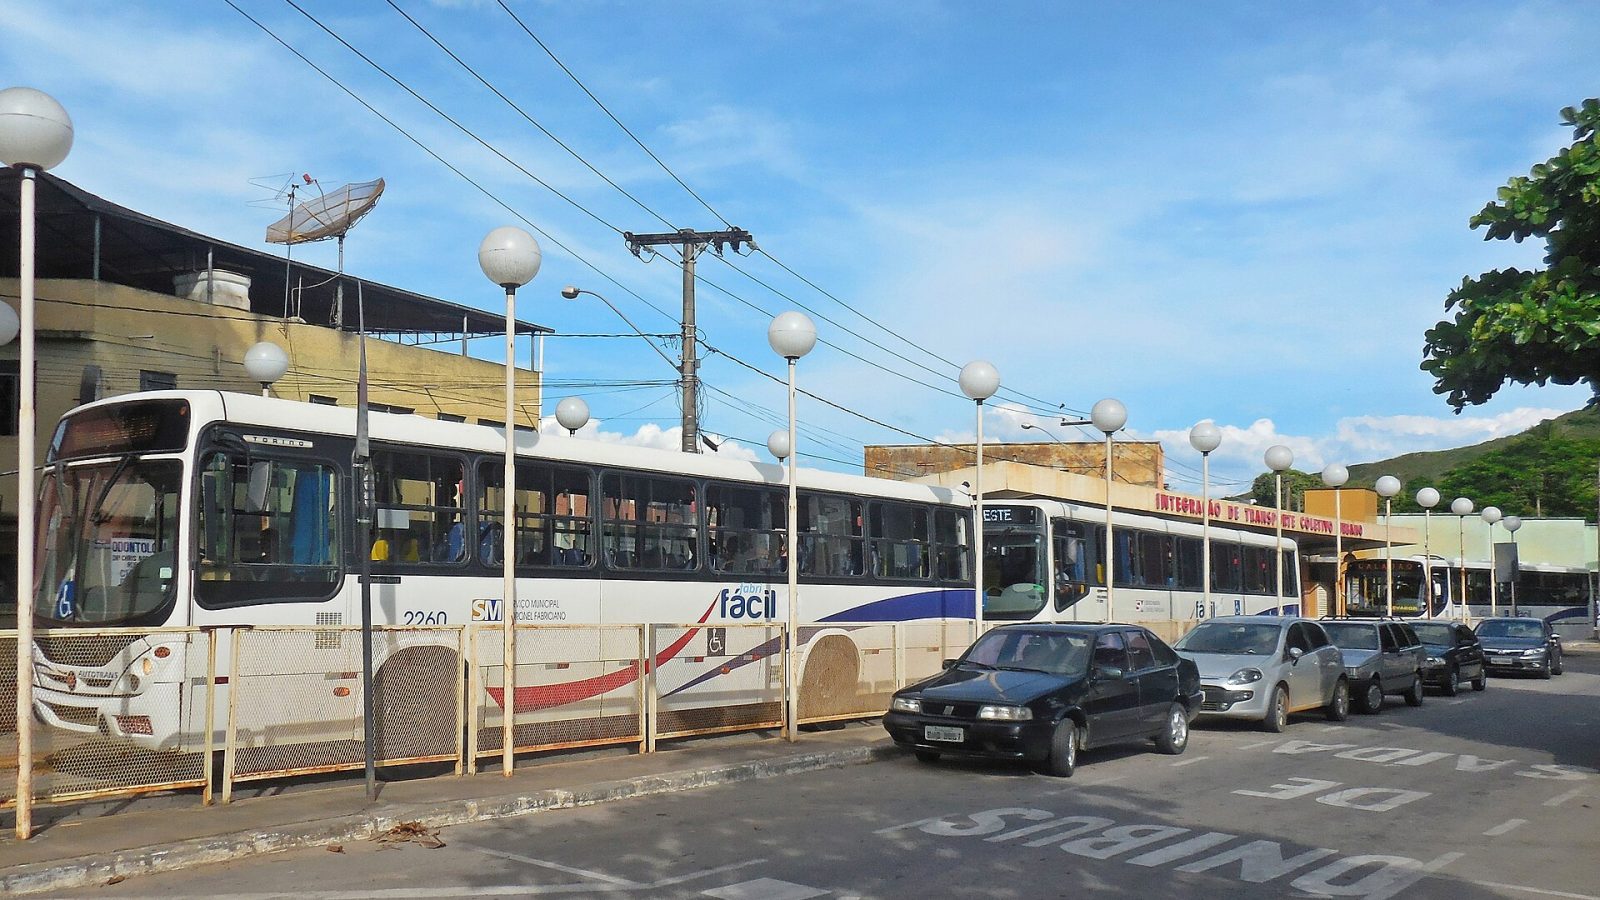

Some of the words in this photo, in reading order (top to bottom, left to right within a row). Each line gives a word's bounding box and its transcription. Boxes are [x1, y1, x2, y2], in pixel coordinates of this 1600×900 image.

[252, 436, 304, 447] TORINO
[983, 508, 1012, 521] ESTE
[1155, 492, 1222, 518] INTEGRAÃO
[1227, 505, 1240, 521] DE
[1243, 507, 1296, 530] TRANSPRTE
[740, 582, 763, 595] fabri
[472, 599, 502, 621] SM
[720, 588, 776, 619] fácil
[1195, 600, 1216, 619] fáil
[404, 610, 447, 625] 2260
[534, 611, 567, 621] FABRICIANO
[1230, 776, 1433, 812] DE
